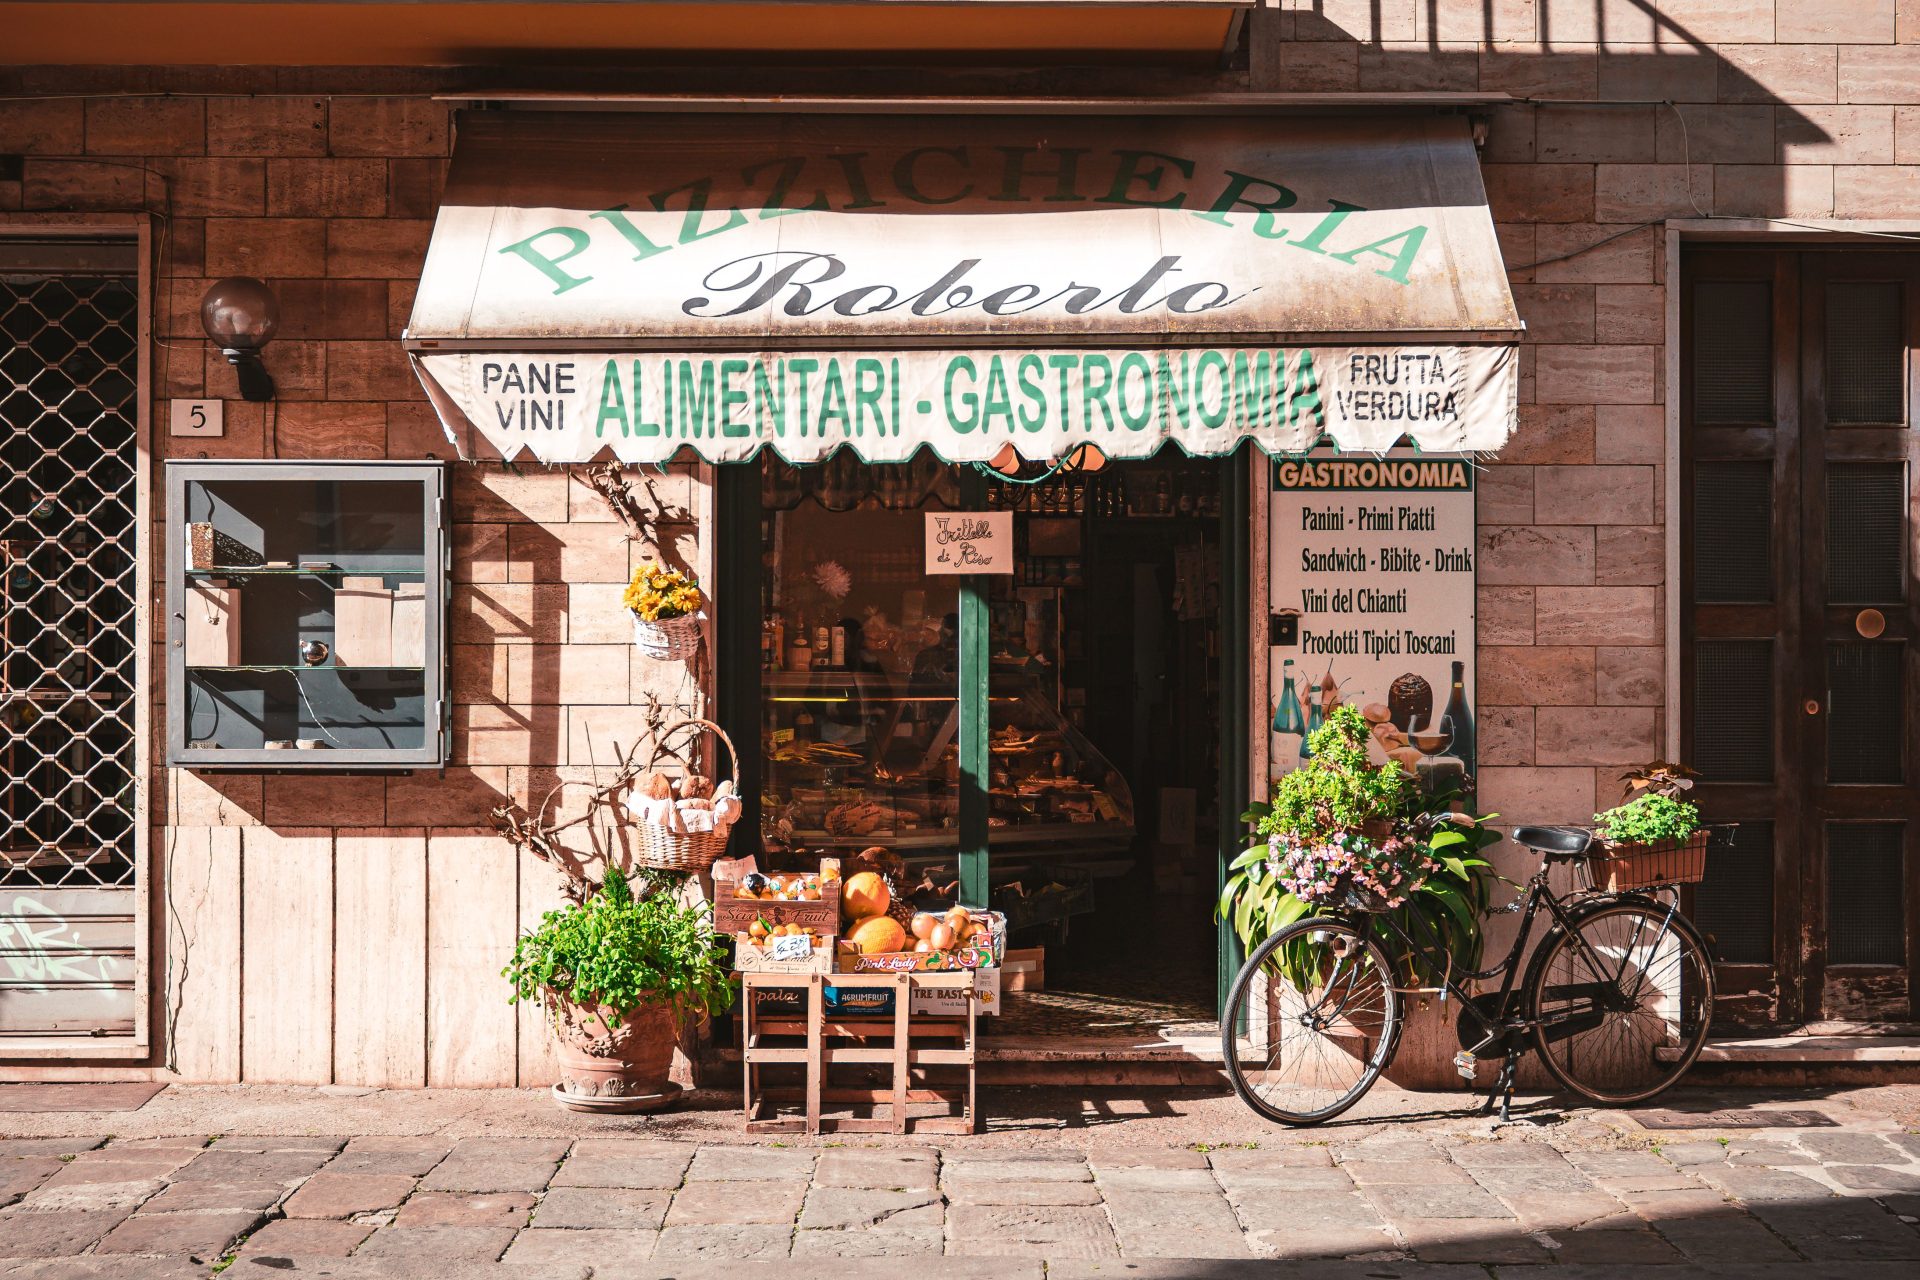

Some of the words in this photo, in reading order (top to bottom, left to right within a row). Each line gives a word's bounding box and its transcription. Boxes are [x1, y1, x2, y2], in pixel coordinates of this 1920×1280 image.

[498, 145, 1429, 295] PIZZICHERIA
[682, 251, 1263, 317] Roberto
[482, 363, 575, 394] PANE
[1351, 354, 1445, 385] FRUTTA
[596, 358, 900, 438] ALIMENTARI
[944, 350, 1323, 435] GASTRONOMIA
[1337, 390, 1459, 421] VERDURA
[191, 405, 206, 428] 5
[495, 400, 563, 431] VINI
[1280, 462, 1468, 488] GASTRONOMIA
[1302, 507, 1344, 531] Panini
[1358, 507, 1394, 531] Primi
[1398, 506, 1435, 531] Piatti
[937, 548, 950, 562] di
[954, 542, 992, 567] Riso
[1302, 548, 1366, 572] Sandwich
[1380, 548, 1421, 572] Bibite
[1435, 548, 1472, 572] Drink
[1302, 588, 1328, 613] Vini
[1332, 588, 1353, 613] del
[1357, 588, 1407, 613] Chianti
[1302, 630, 1358, 654] Prodotti
[1363, 630, 1400, 660] Tipici
[1404, 630, 1456, 654] Toscani
[854, 957, 886, 970] Pink
[886, 957, 916, 972] Lady
[914, 989, 933, 999] TRE
[937, 989, 985, 1000] BASTNI
